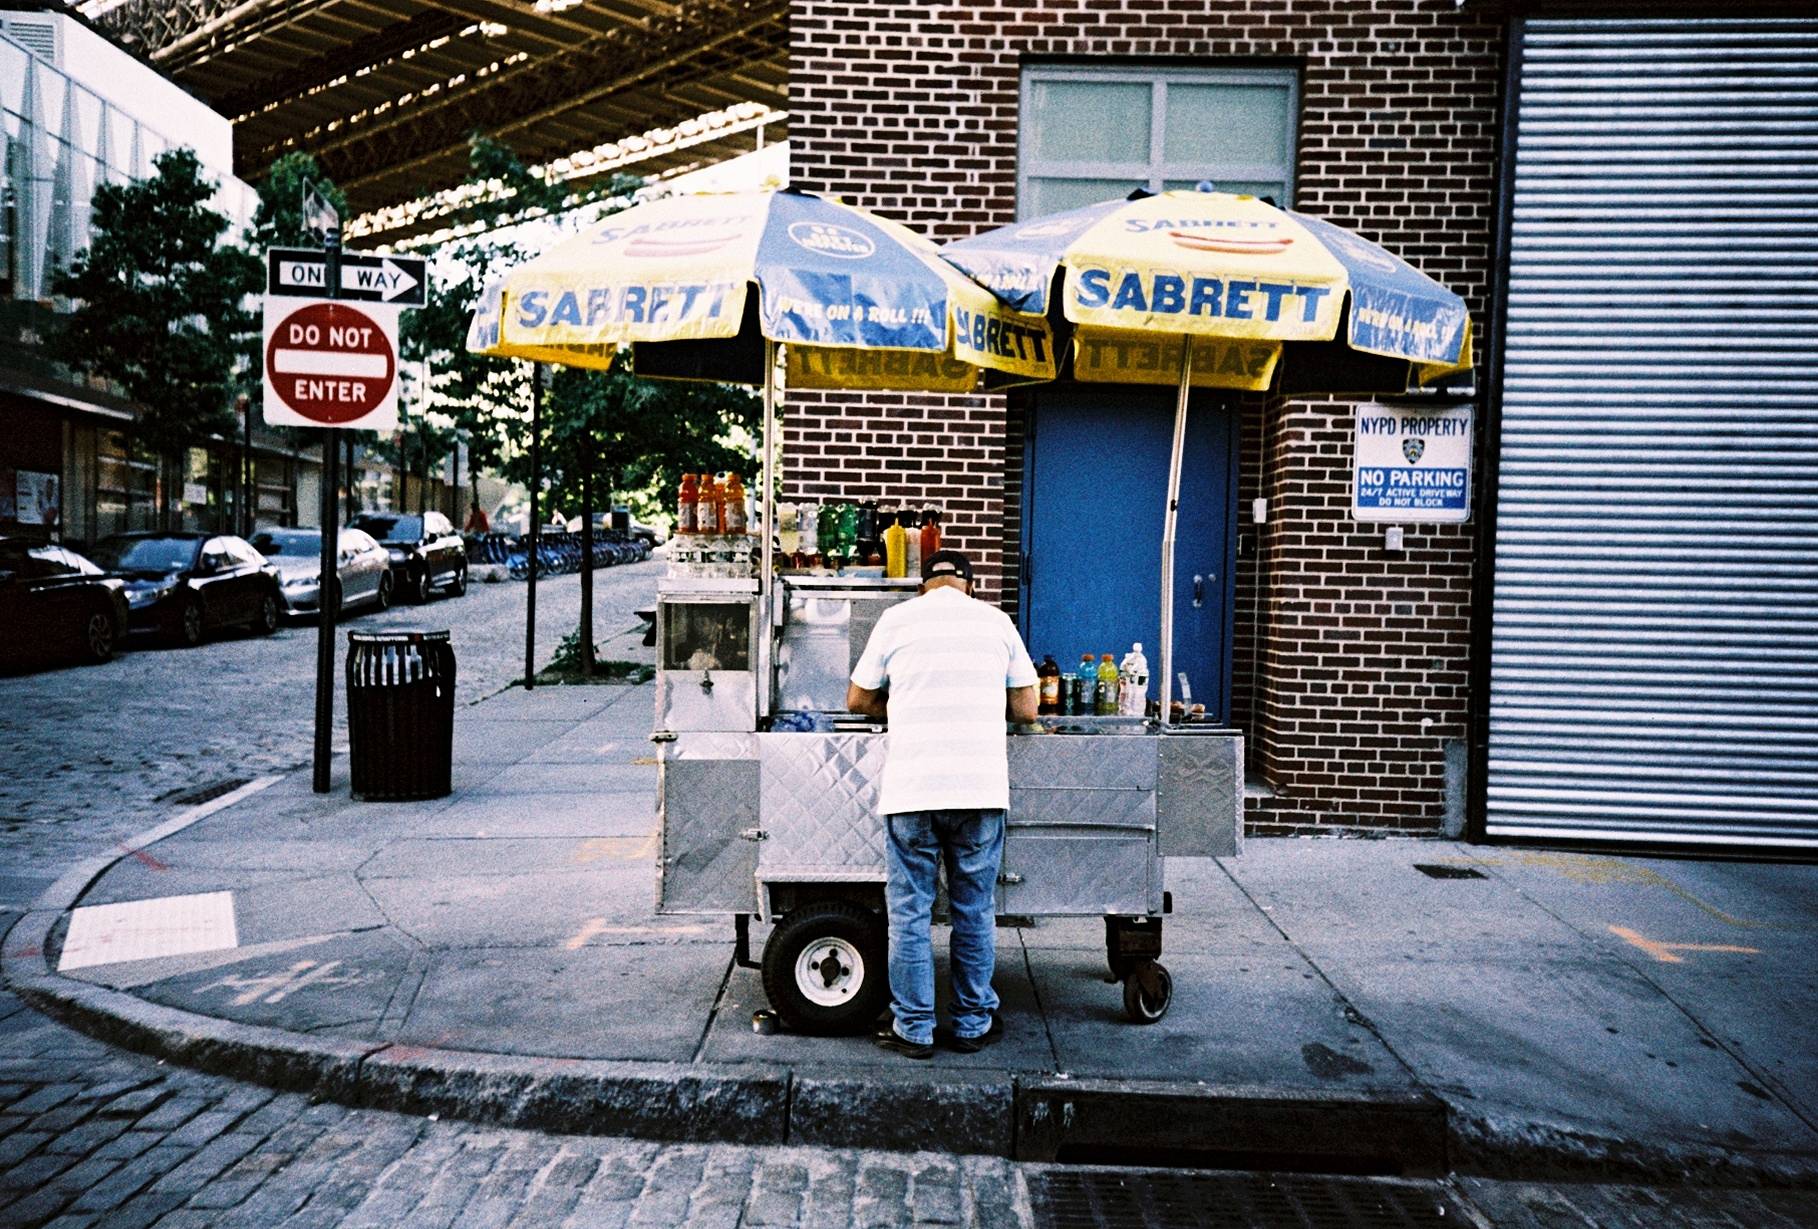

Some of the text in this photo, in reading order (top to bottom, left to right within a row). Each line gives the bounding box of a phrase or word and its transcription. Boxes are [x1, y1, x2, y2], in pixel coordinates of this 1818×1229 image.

[292, 265, 401, 289] ON WAY
[1074, 268, 1331, 323] SABRETT
[827, 305, 850, 321] ON
[868, 307, 908, 325] ROLL
[290, 323, 373, 349] DO NOT
[295, 378, 367, 403] ENTER
[1361, 416, 1469, 436] NYPD PROPERTY
[1361, 469, 1465, 488] NO PARKING
[1360, 487, 1463, 498] 24/7 ACTIVE DRIVEWAY
[1379, 498, 1444, 507] DO NOT BLOCK
